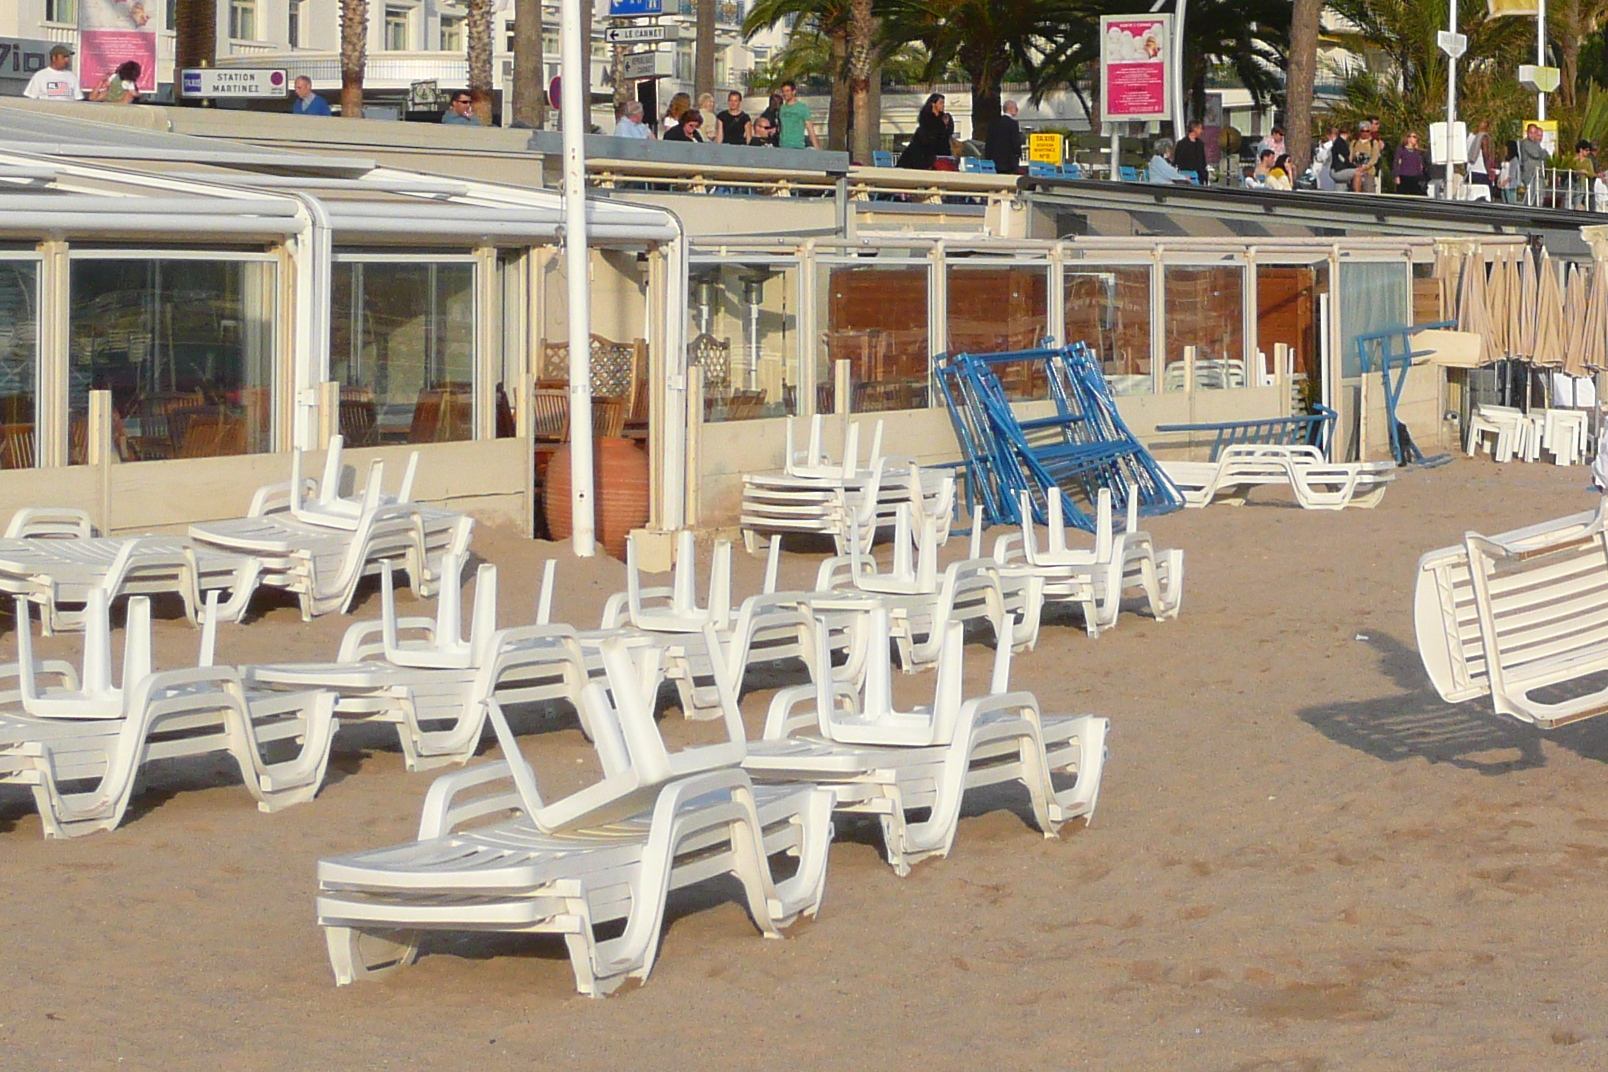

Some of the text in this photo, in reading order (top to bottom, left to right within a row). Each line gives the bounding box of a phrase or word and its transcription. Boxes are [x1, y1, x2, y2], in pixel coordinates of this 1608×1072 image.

[625, 29, 662, 38] LE CANNET
[217, 73, 256, 81] STATION
[212, 85, 260, 93] MARTINEZ
